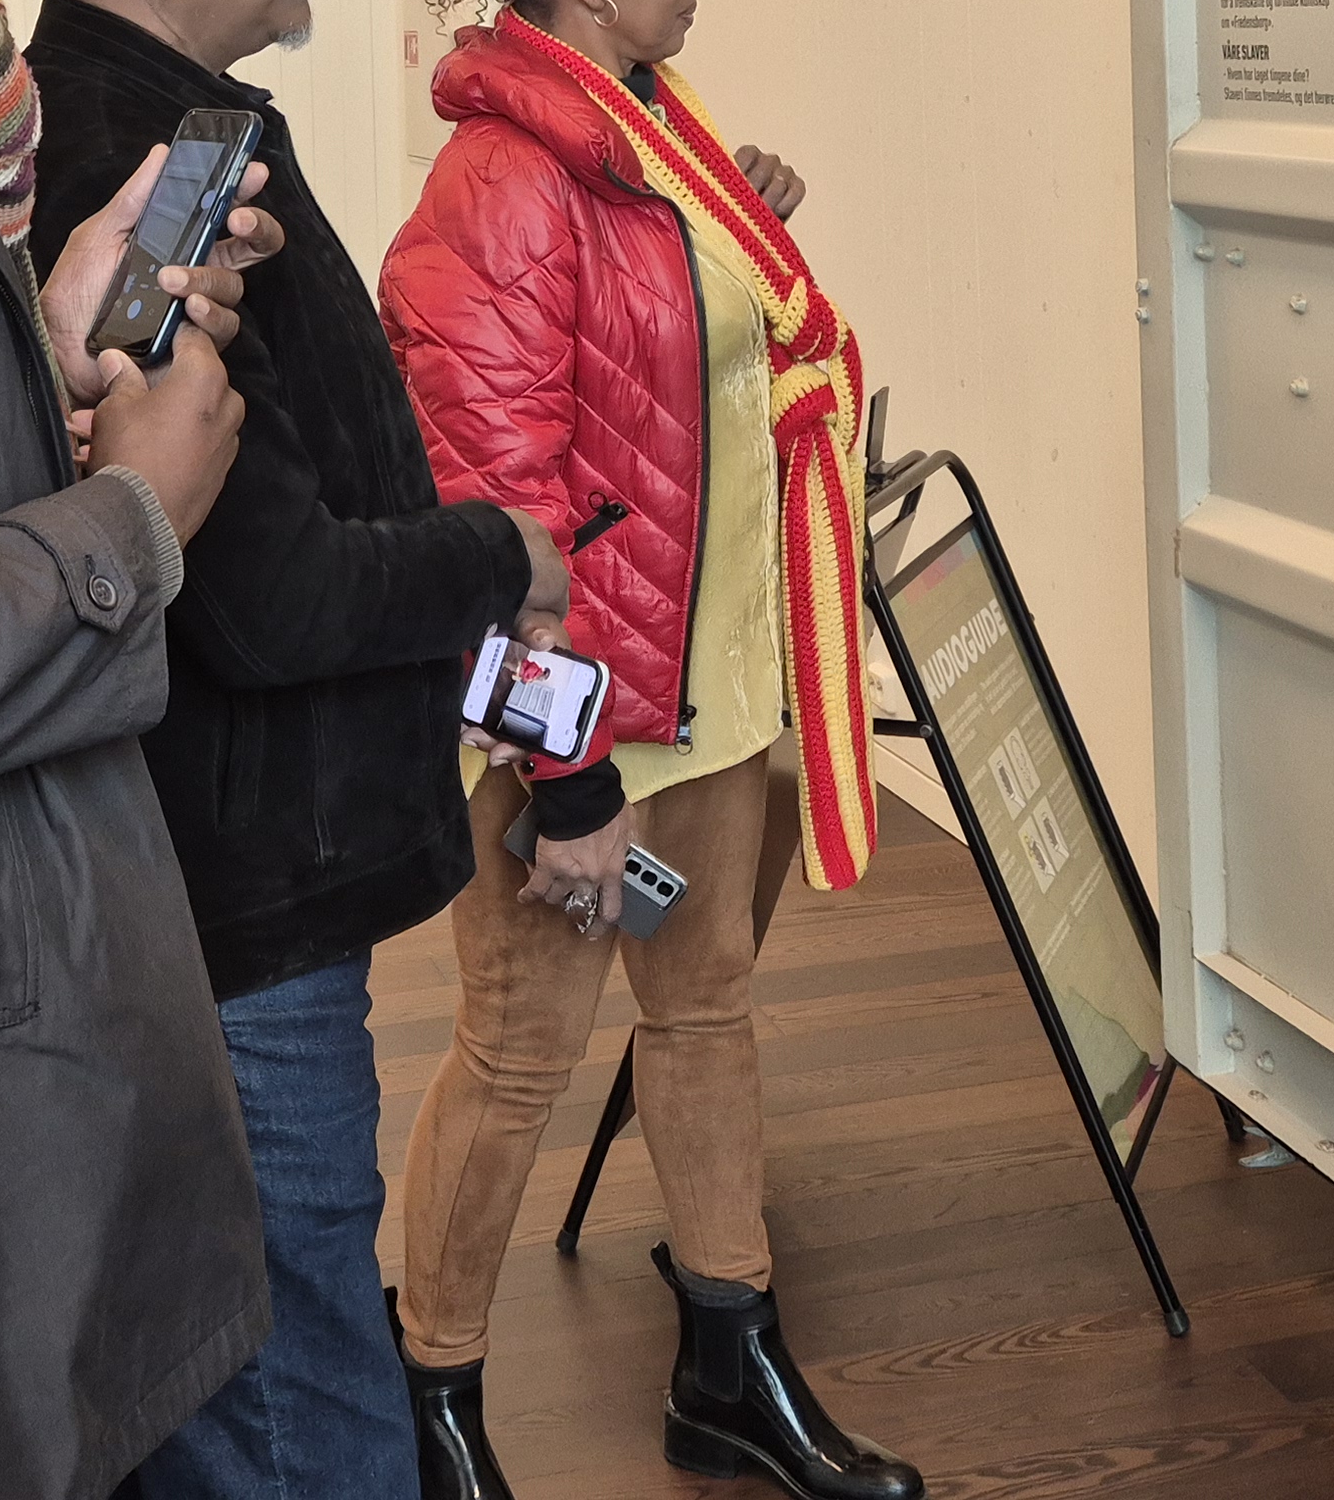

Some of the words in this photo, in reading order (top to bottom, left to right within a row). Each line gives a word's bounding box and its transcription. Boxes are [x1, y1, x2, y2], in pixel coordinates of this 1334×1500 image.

[1221, 38, 1241, 60] VÅRE
[1241, 44, 1270, 60] SLAVER
[920, 598, 1009, 706] AUDIOGUIDE
